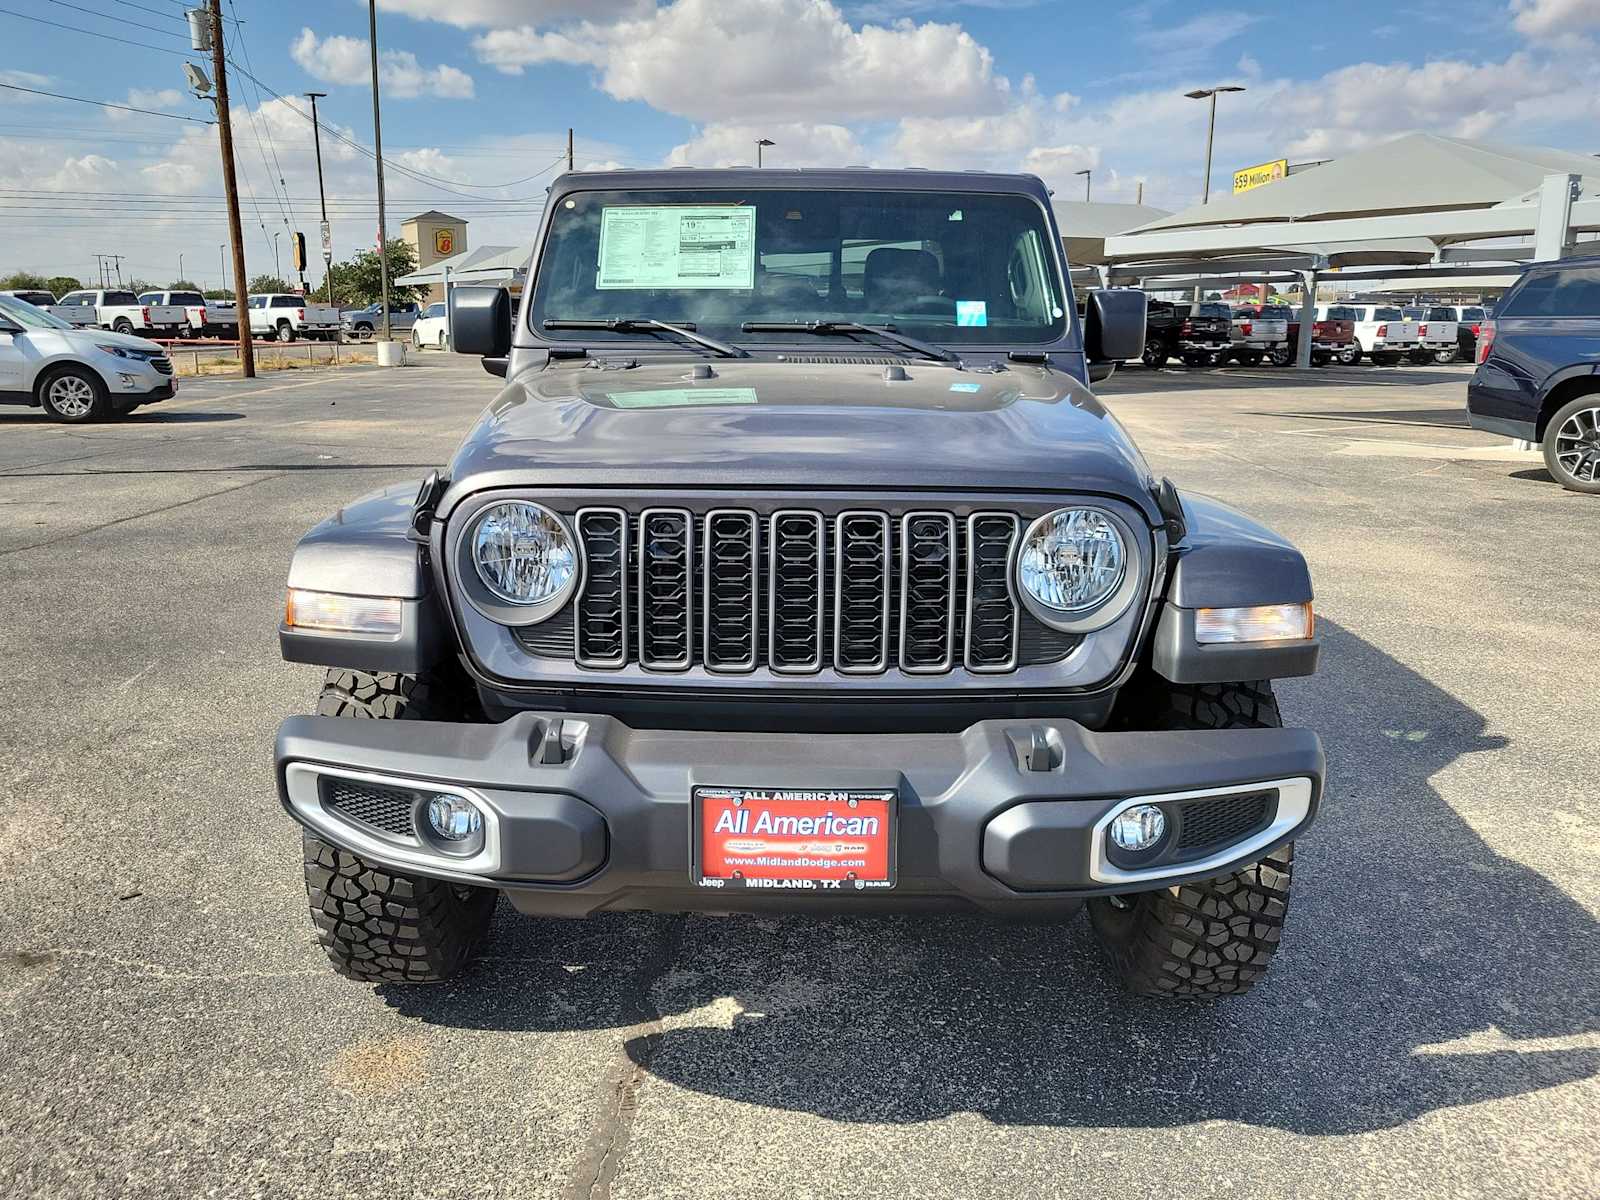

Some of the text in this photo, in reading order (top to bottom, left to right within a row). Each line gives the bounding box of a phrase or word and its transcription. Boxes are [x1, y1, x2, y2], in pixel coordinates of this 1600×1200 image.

[1234, 173, 1270, 189] $59 Million
[743, 791, 848, 801] ALL AMERICN
[714, 809, 878, 835] All American
[724, 857, 865, 868] www.MidlandDodge.com
[699, 877, 725, 889] Jeep
[746, 879, 841, 889] MIDLAND, TX
